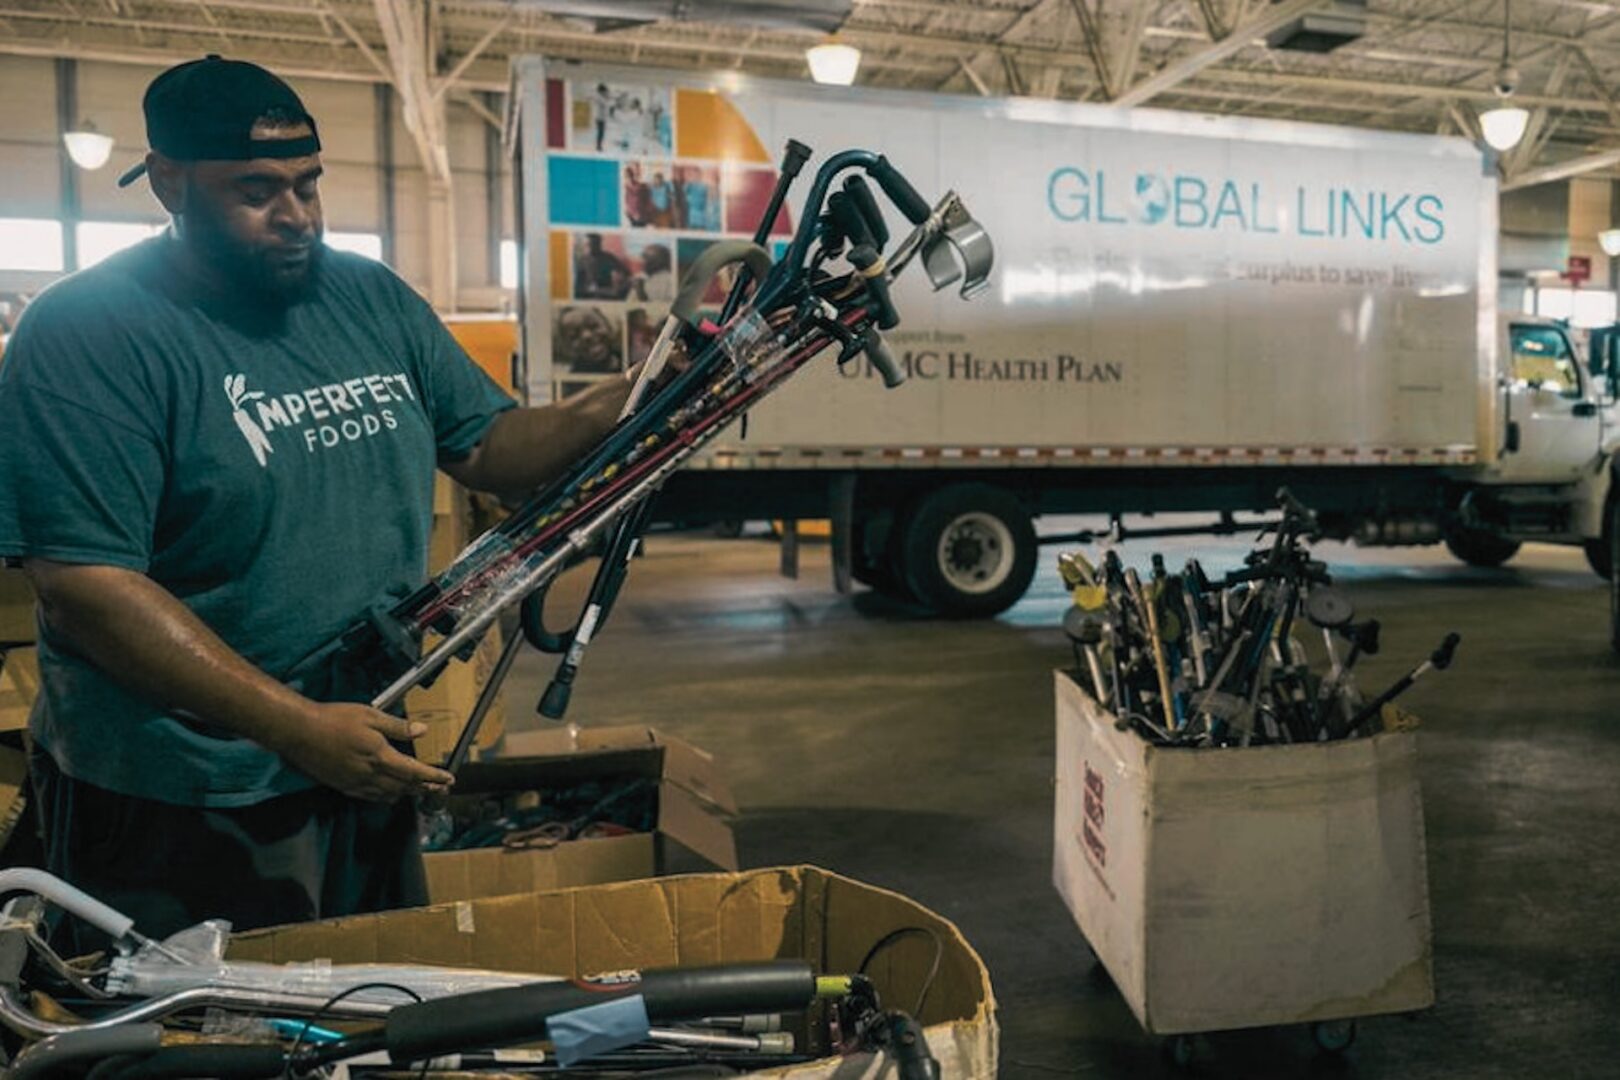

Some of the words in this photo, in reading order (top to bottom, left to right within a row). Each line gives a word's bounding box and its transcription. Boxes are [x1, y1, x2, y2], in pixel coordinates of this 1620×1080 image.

[1047, 166, 1279, 234] GLOBAL
[1297, 185, 1444, 244] LINKS
[1319, 263, 1341, 284] to
[303, 409, 398, 453] FOODS
